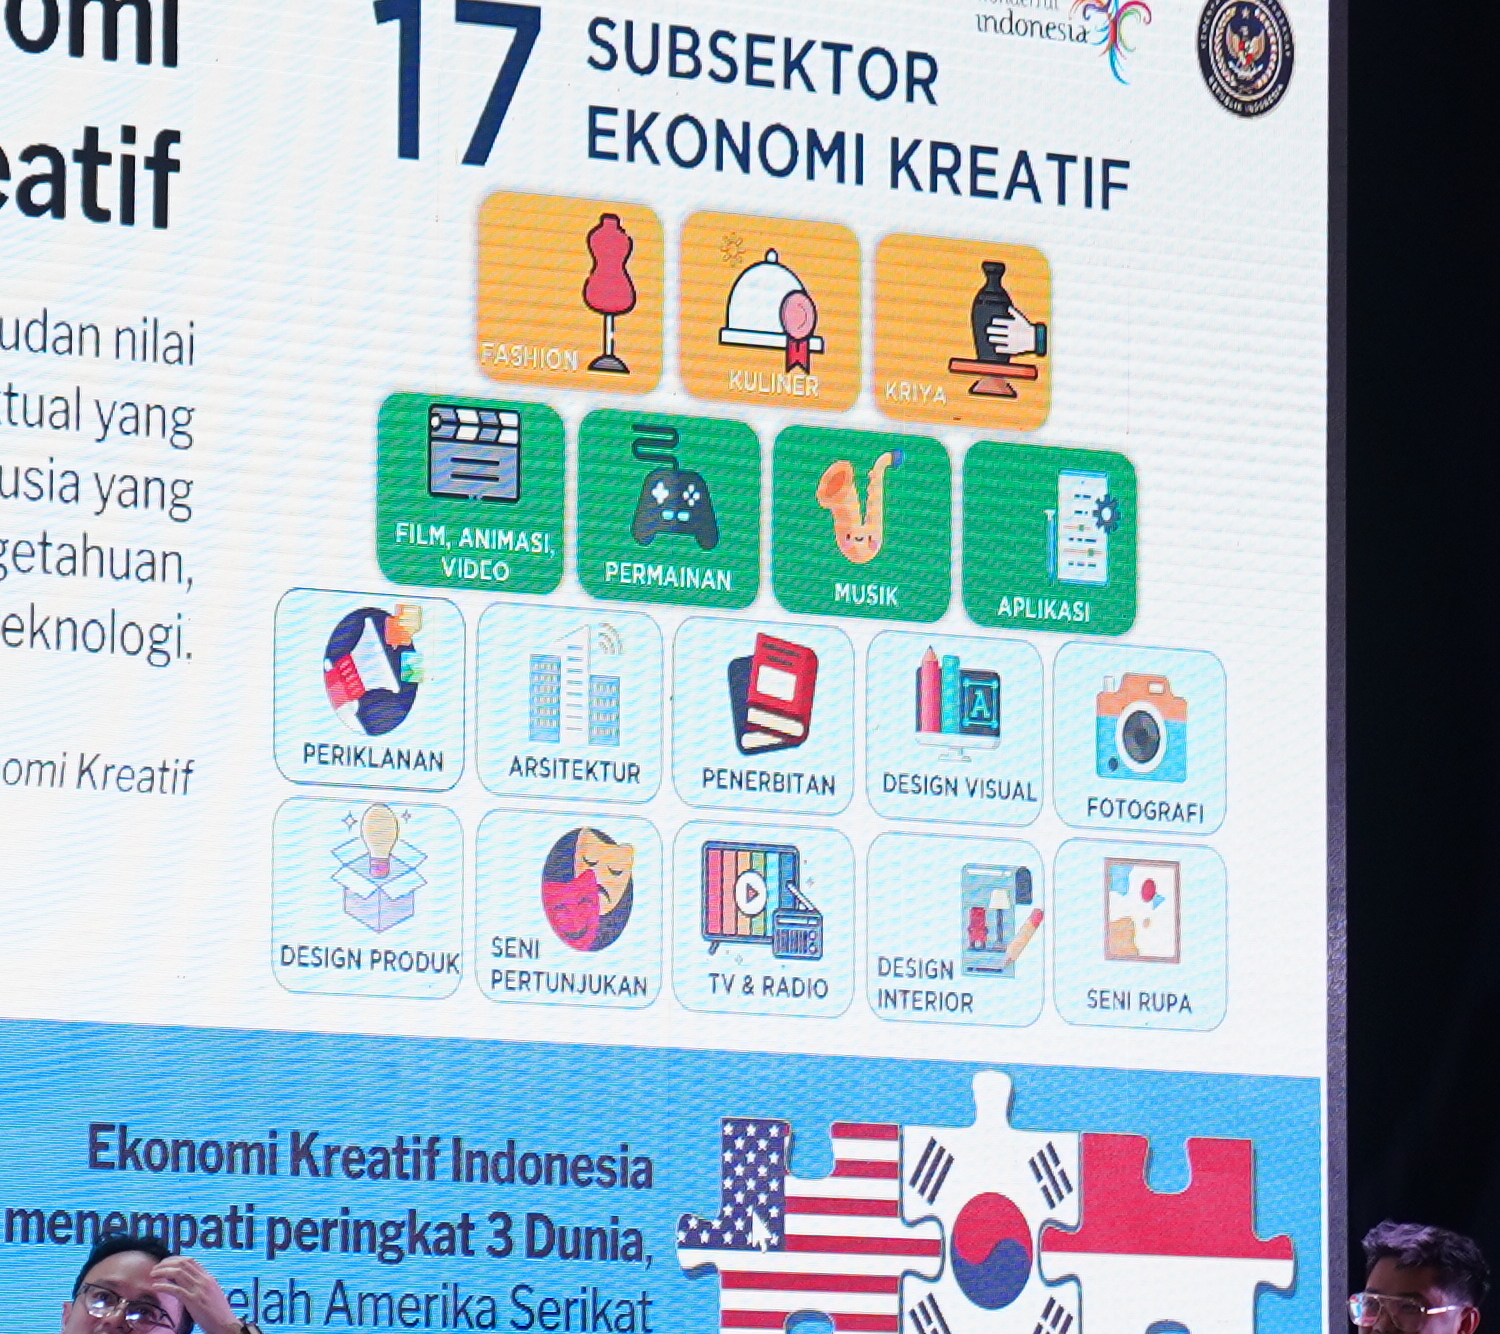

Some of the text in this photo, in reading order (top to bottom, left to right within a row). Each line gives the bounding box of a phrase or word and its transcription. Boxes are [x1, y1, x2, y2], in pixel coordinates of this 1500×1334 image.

[976, 9, 1092, 43] indonesia
[587, 16, 939, 106] SUBSEKTOR
[587, 104, 1131, 211] EKONOMI KREATIF
[114, 316, 195, 366] nilai
[480, 342, 948, 406] FASHION KULINER KRIYA
[94, 399, 196, 451] yang
[93, 472, 194, 524] yang
[394, 522, 557, 558] FILM, ANIMASI,
[441, 556, 510, 583] VIDEO
[604, 561, 1090, 624] PERMAINAN MUSIK APLIKASI
[76, 752, 195, 796] Kreatif
[303, 742, 836, 796] PERIKLANAN ARSITEKTUR PENERBITAN
[882, 771, 1038, 803] DESIGN VISUAL
[1087, 796, 1204, 824] FOTOGRAFI
[280, 943, 460, 975] DESIGN PRODUK
[491, 935, 540, 960] SENI
[490, 968, 648, 997] PERTUNJUKAN
[707, 972, 829, 1000] TV & RADIO
[877, 955, 955, 981] DESIGN
[877, 988, 974, 1013] INTERIOR
[1086, 988, 1193, 1014] SENI RUPA
[88, 1122, 654, 1191] Ekonomi Kreatif Indonesia
[4, 1203, 653, 1270] menempati peringkat 3 Dunia,
[323, 1278, 499, 1331] Amerika
[509, 1283, 654, 1334] Serikat
